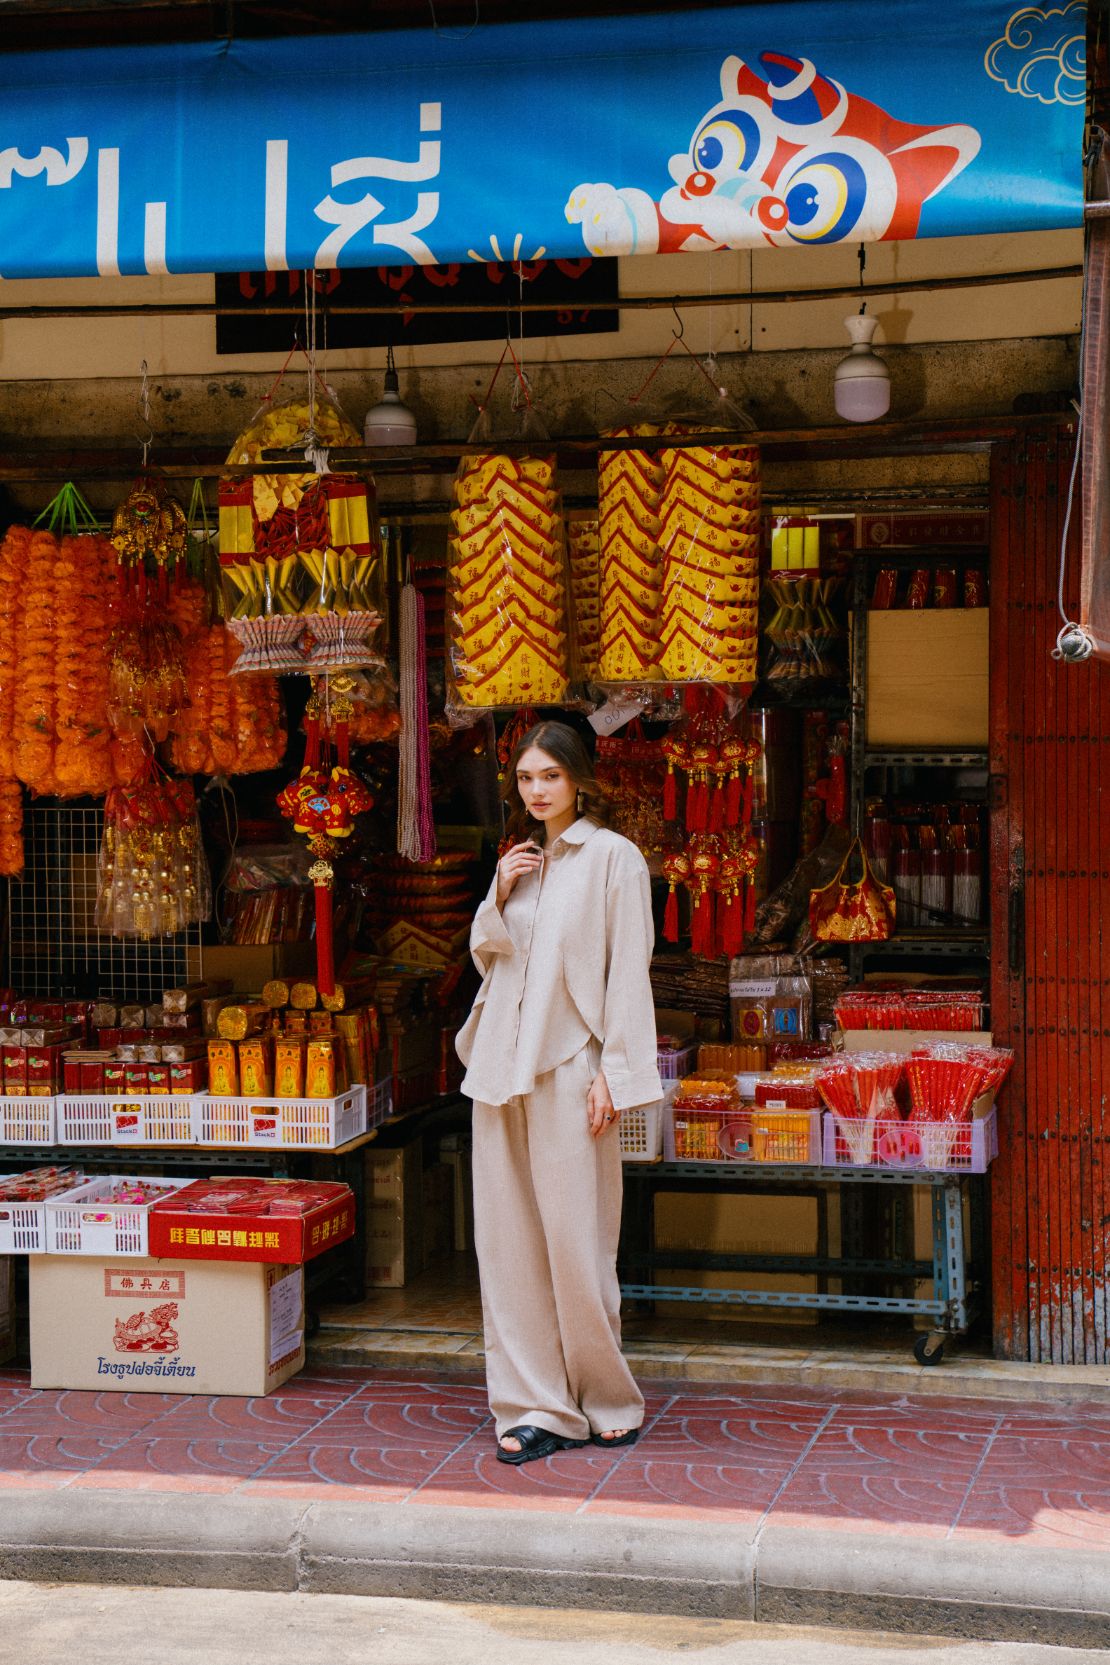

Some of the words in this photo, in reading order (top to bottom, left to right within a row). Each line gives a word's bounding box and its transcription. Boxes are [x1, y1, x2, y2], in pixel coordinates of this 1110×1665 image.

[170, 1228, 280, 1248] 瑞祥精品利是封
[120, 1277, 171, 1291] 佛具店
